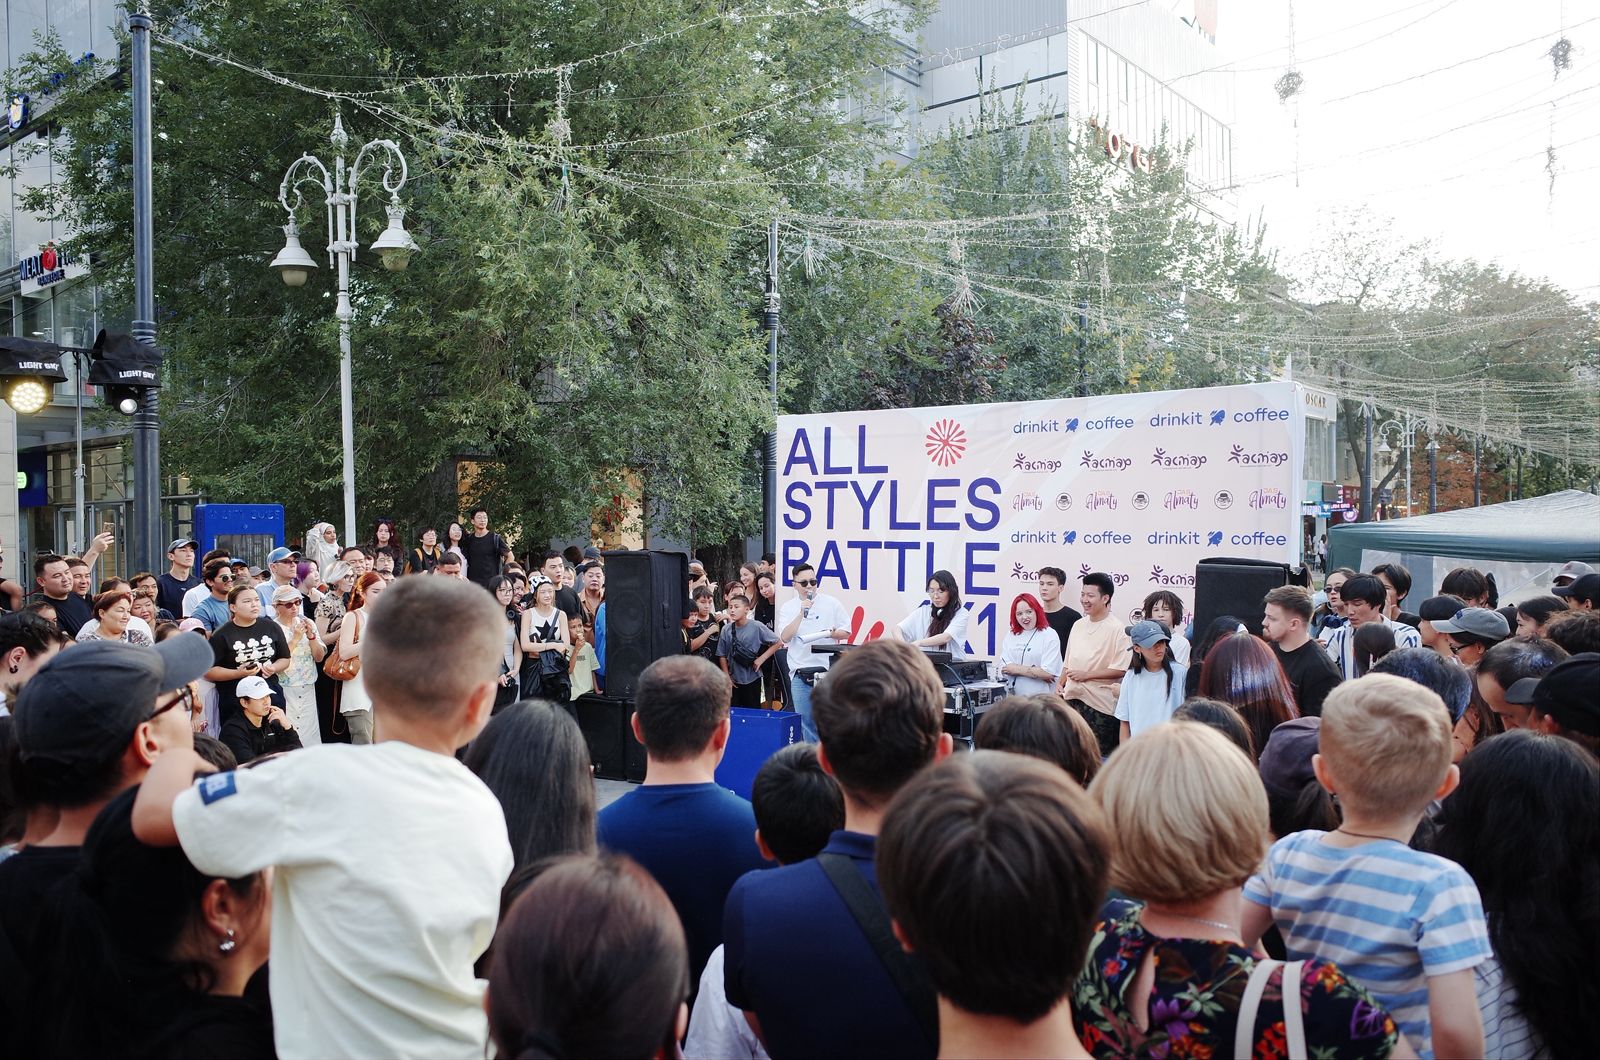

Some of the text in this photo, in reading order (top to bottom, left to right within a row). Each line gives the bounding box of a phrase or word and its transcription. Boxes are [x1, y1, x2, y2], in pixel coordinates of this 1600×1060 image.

[19, 361, 42, 370] LIGHT
[119, 370, 142, 379] LIGHT
[1013, 416, 1134, 434] drinkit coffee
[1149, 407, 1290, 427] drinkit coffee
[782, 424, 889, 477] ALL
[782, 477, 1002, 532] STYLES
[1012, 493, 1043, 511] Almaty
[1085, 492, 1118, 511] Almaty
[1163, 490, 1199, 511] Almaty
[1248, 488, 1287, 511] Almaty
[1010, 531, 1132, 545] drinkit coffee
[1147, 531, 1287, 546] drinkit coffee
